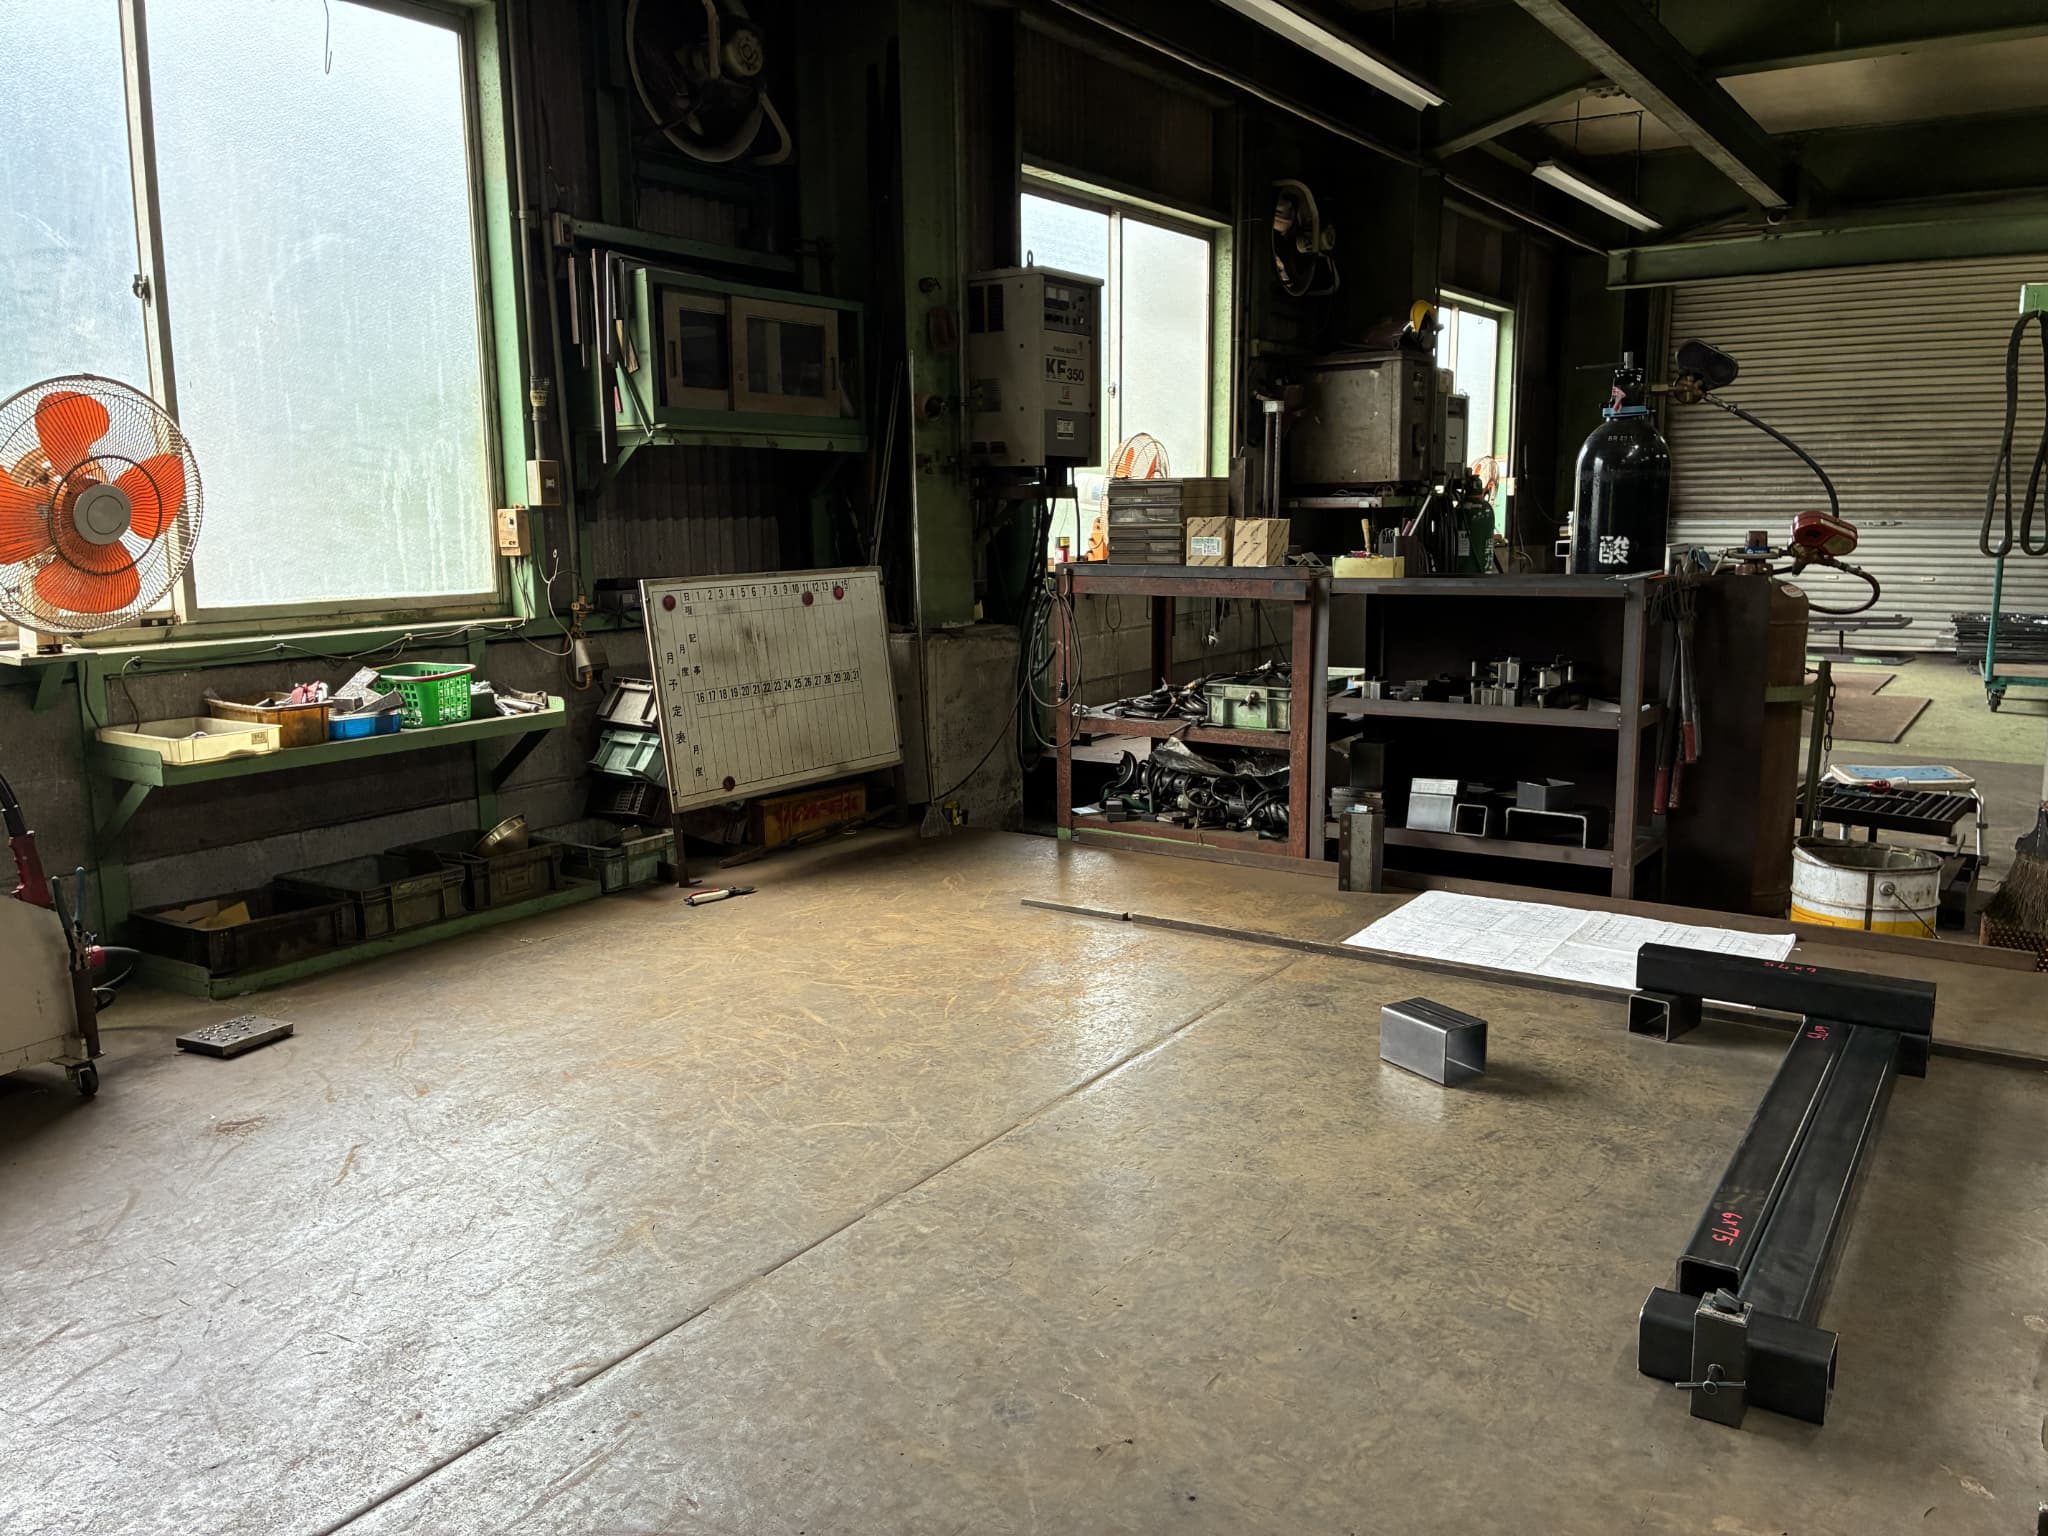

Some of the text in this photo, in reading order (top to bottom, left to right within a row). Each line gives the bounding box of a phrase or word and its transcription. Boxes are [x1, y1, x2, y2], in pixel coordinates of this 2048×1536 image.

[1599, 536, 1629, 564] 酸
[696, 670, 859, 703] 16 17 18 19 20 21 22 23 24 25 26 27 28 29 30 31
[1711, 1212, 1743, 1246] 6x75
